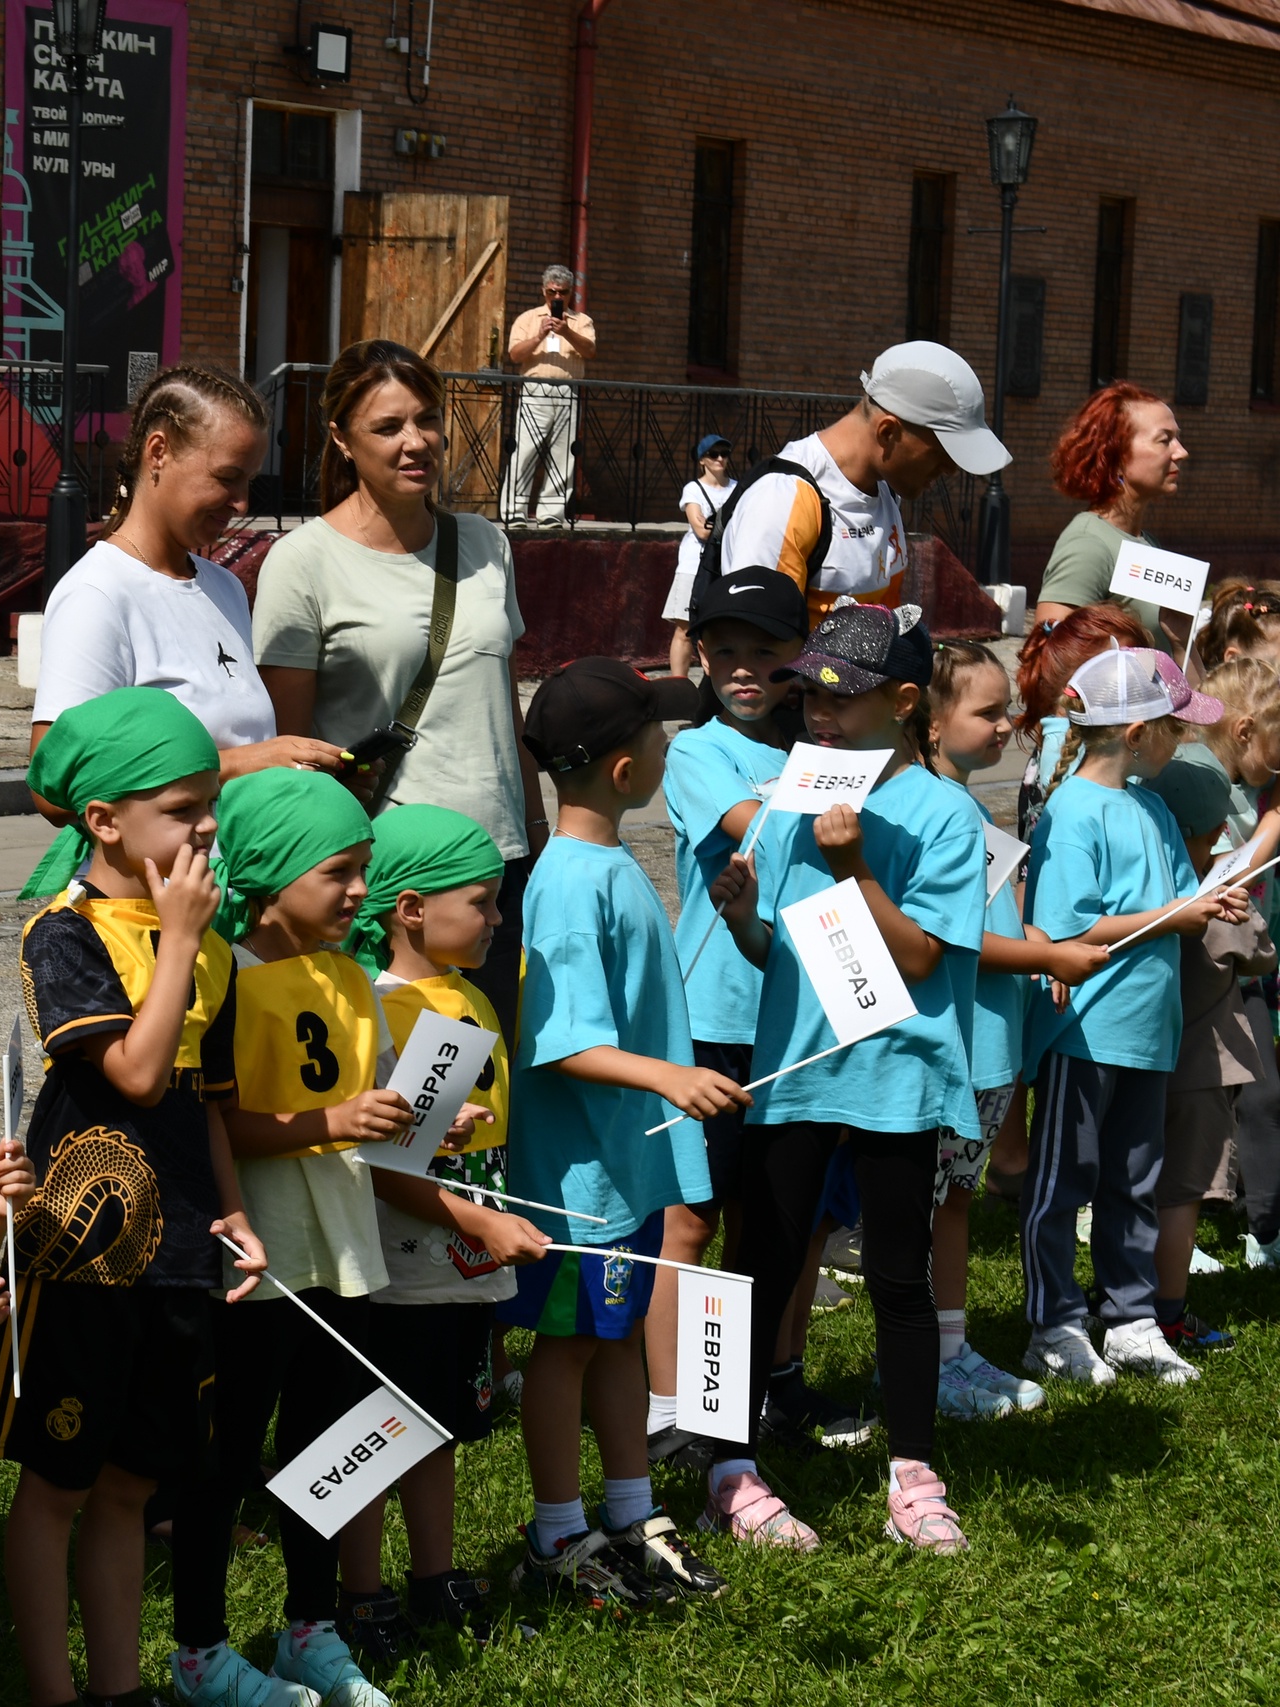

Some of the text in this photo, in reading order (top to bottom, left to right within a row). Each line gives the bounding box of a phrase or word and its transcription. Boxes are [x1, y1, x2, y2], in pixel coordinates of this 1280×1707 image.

[33, 19, 156, 56] ПКИН
[33, 155, 116, 179] КУЛУРЫ
[43, 130, 69, 147] МИ
[92, 209, 163, 273] КАРТА
[1143, 567, 1192, 593] ЕВРАЗ
[813, 774, 867, 790] ЕВРАЗ
[827, 928, 878, 1010] ЕВРАЗ
[296, 1010, 340, 1093] 3
[411, 1041, 460, 1128] ЕВРАЗ
[702, 1320, 722, 1413] ЕВРАЗ
[308, 1430, 388, 1501] ЕВРАЗ
